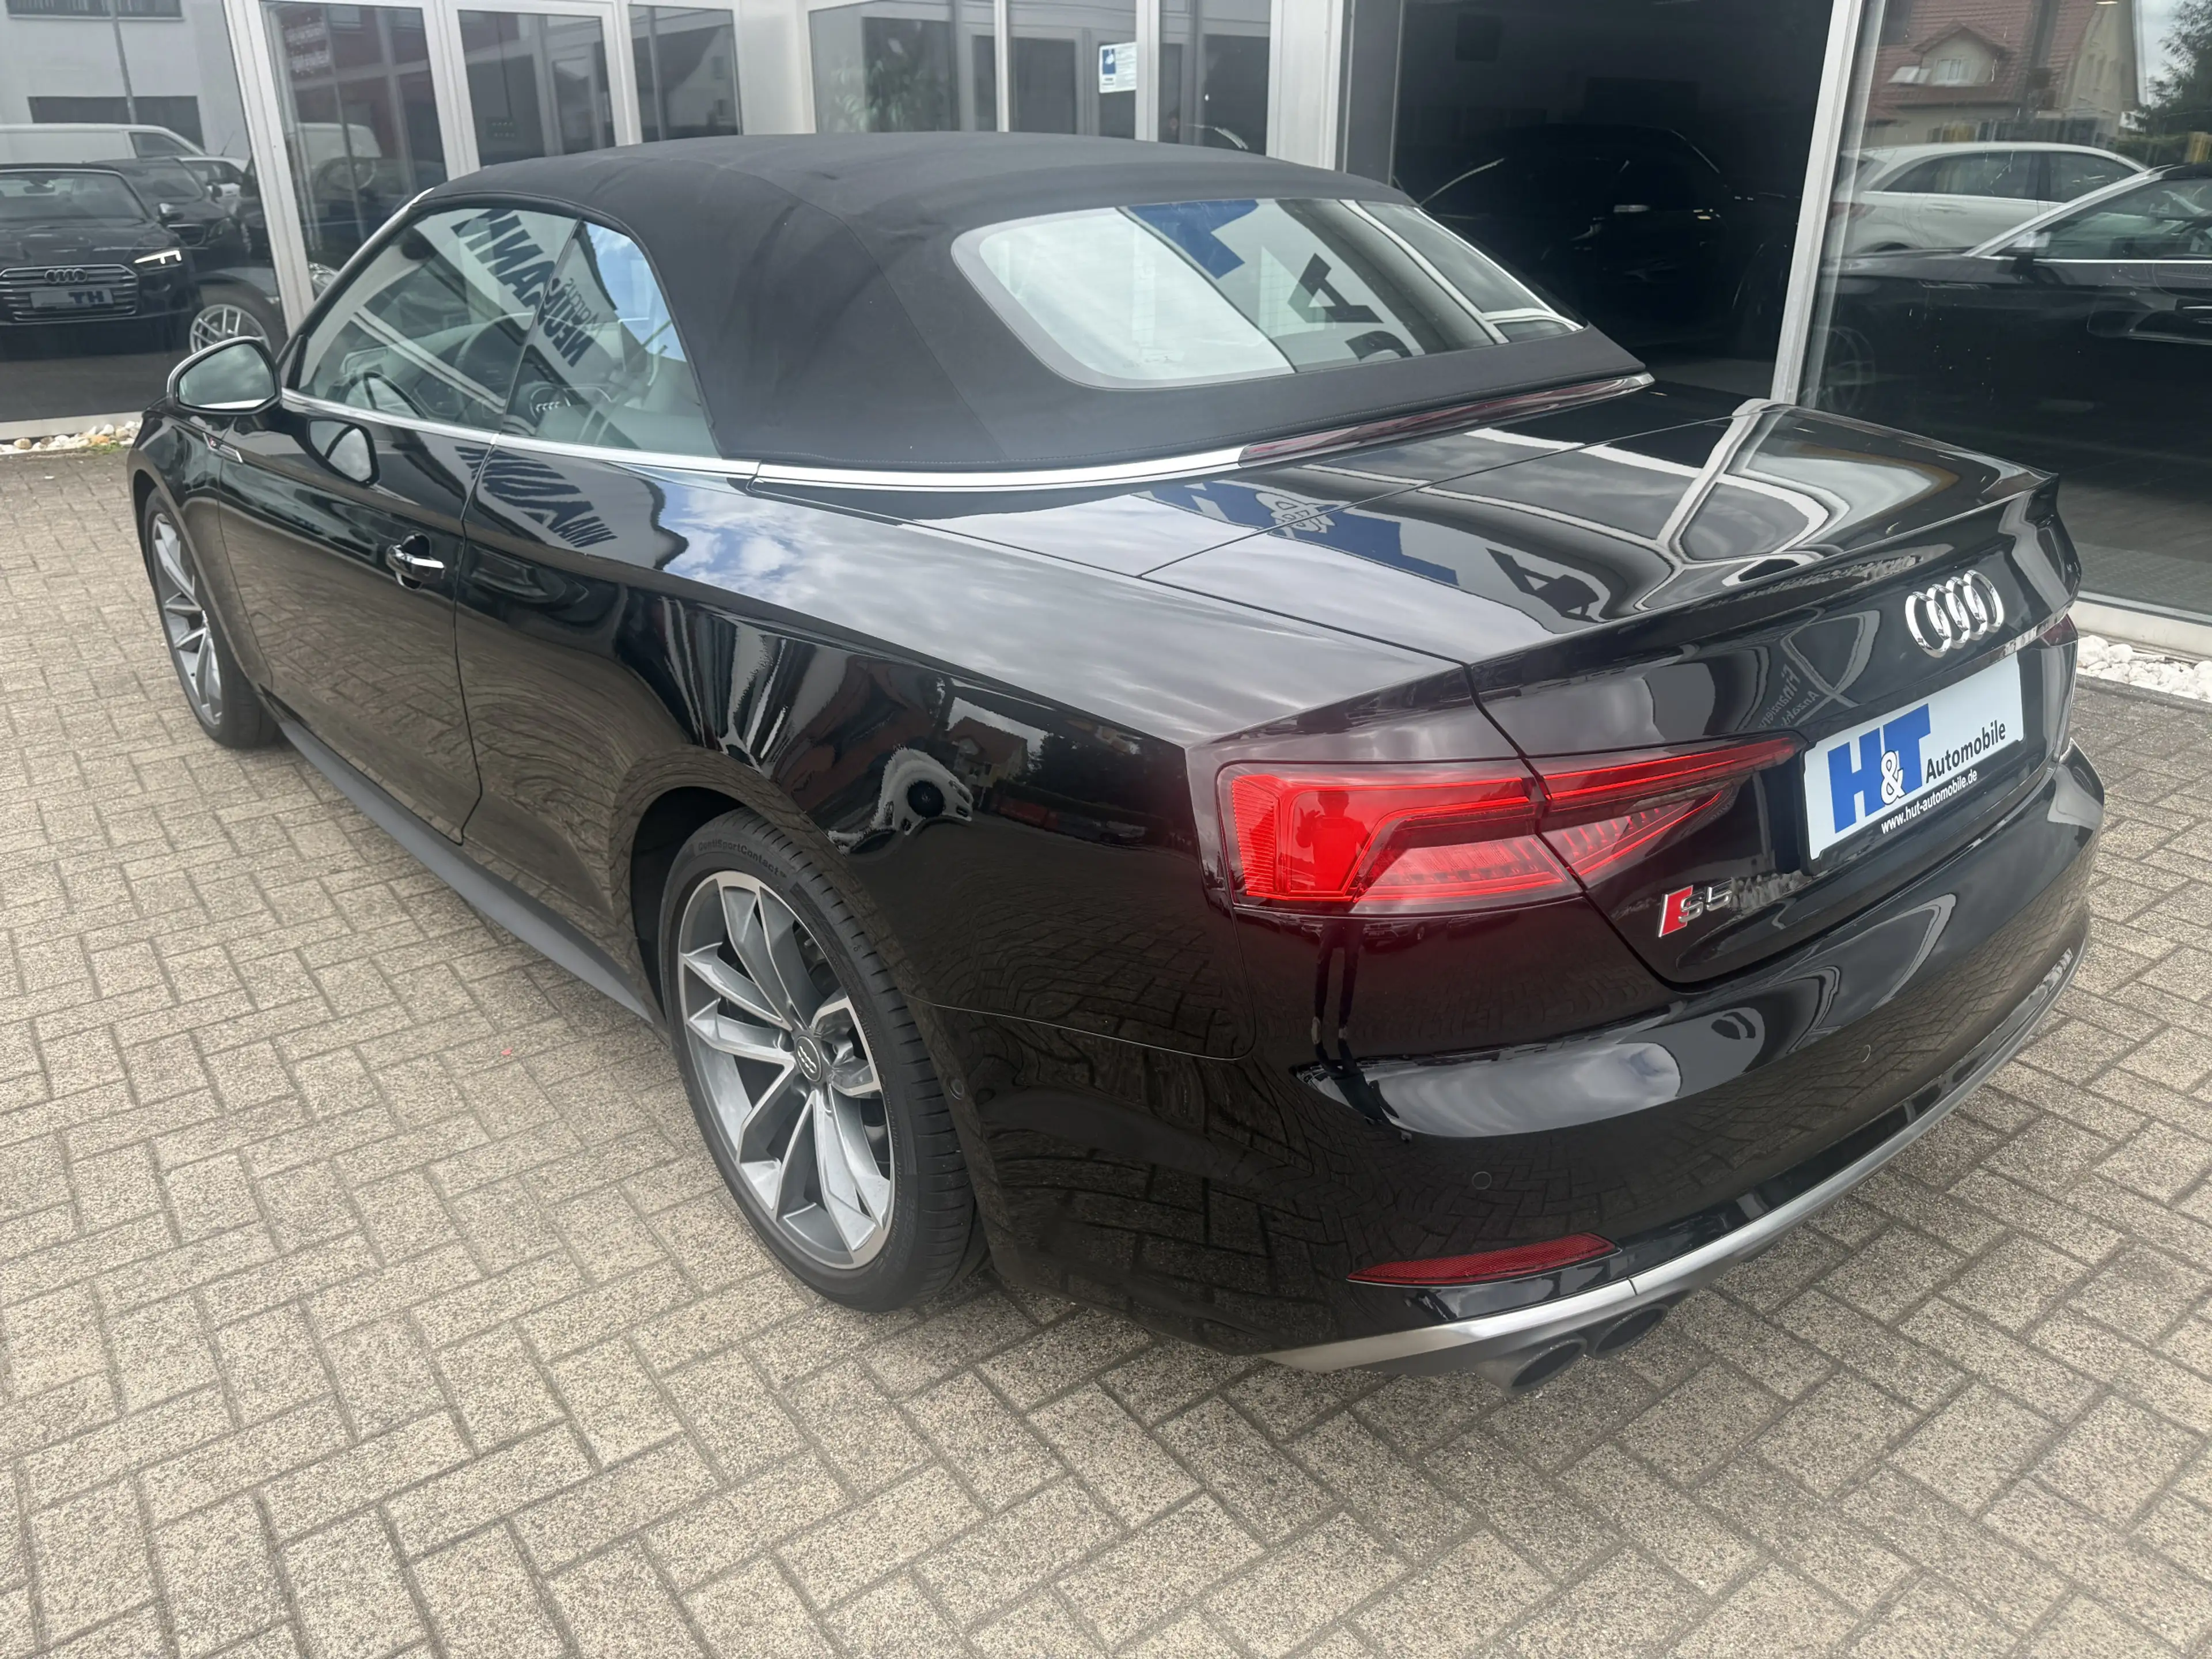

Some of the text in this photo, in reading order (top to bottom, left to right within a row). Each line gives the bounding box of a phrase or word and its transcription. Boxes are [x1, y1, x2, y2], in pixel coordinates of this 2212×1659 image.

[1828, 703, 1931, 834] H&T
[1926, 720, 2006, 783] Automobile
[1881, 768, 1978, 834] www.hut-automobile.de
[1678, 879, 1732, 923] S5
